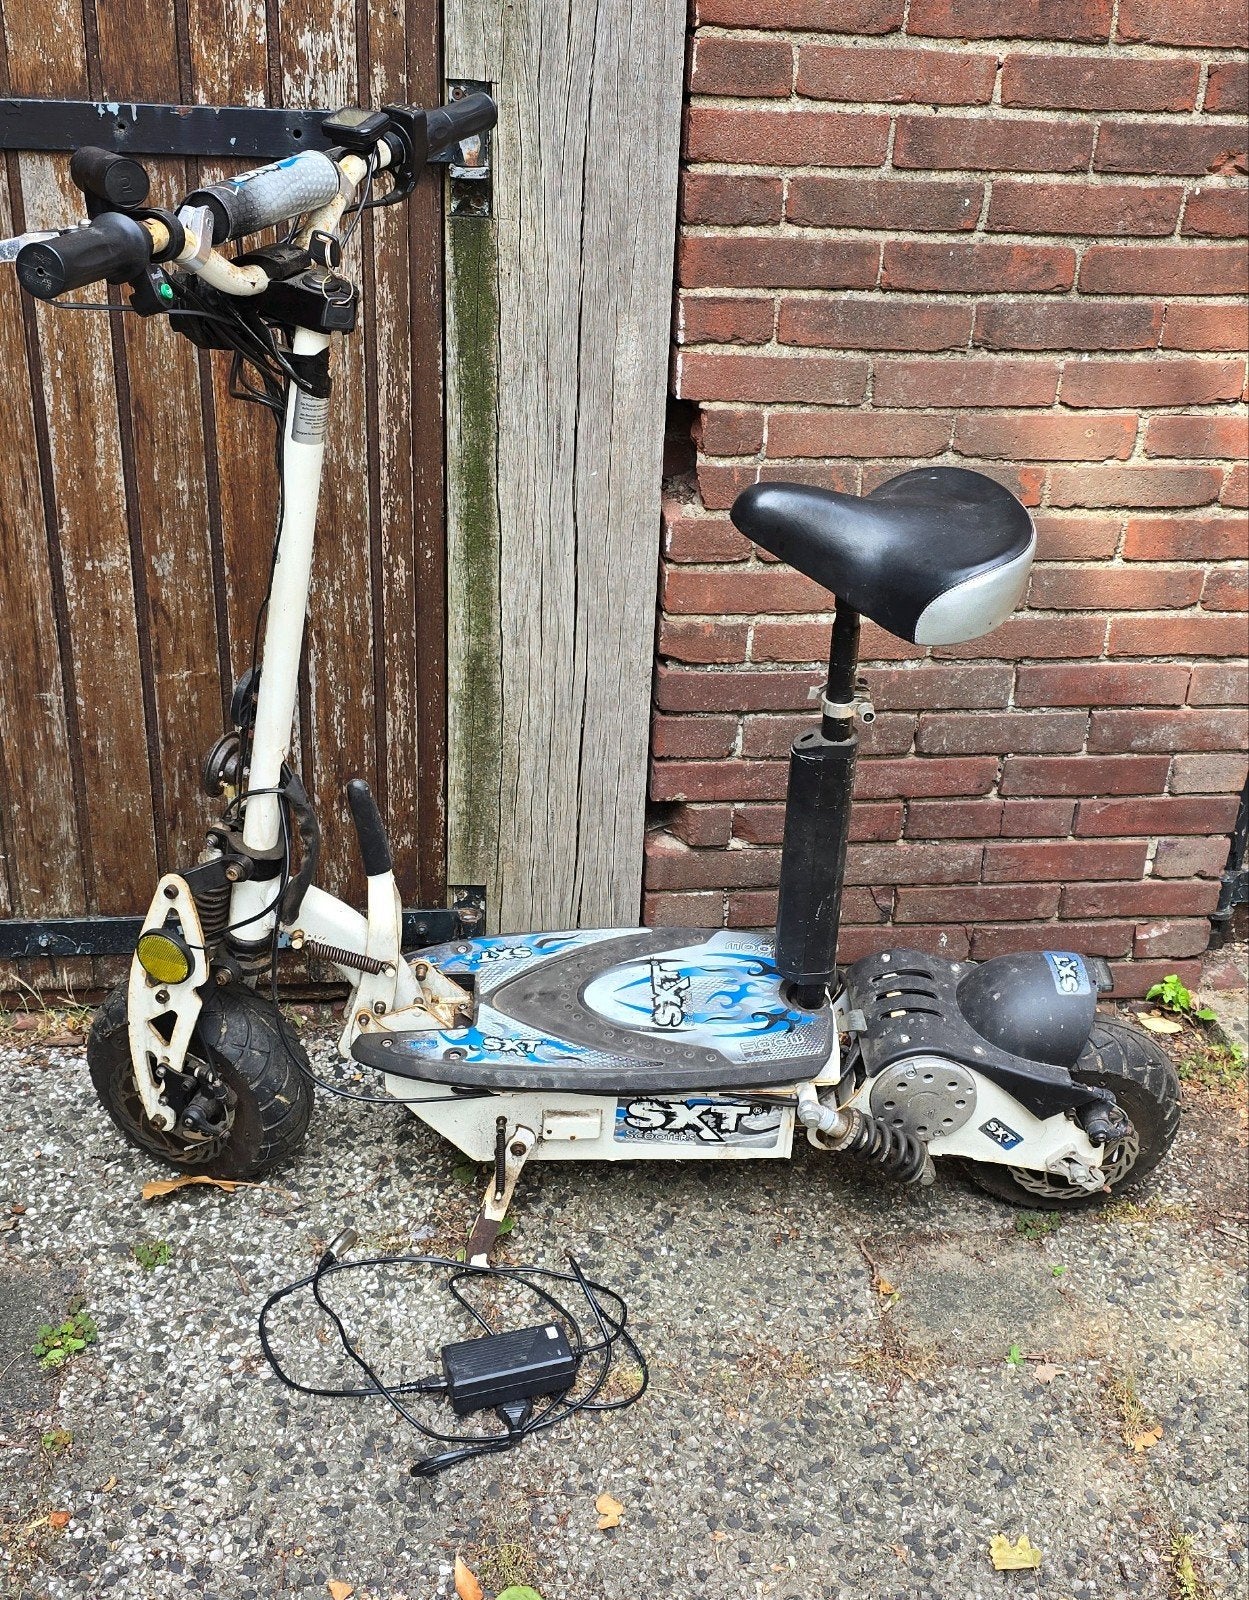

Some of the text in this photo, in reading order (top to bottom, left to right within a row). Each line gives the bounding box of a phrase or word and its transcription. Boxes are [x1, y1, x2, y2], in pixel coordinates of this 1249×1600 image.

[477, 946, 532, 963] SXT
[1051, 953, 1079, 992] SXT
[646, 962, 690, 1027] SXT
[482, 1036, 541, 1057] SXT
[625, 1130, 695, 1142] SCOOTERS
[986, 1121, 1017, 1143] SXT
